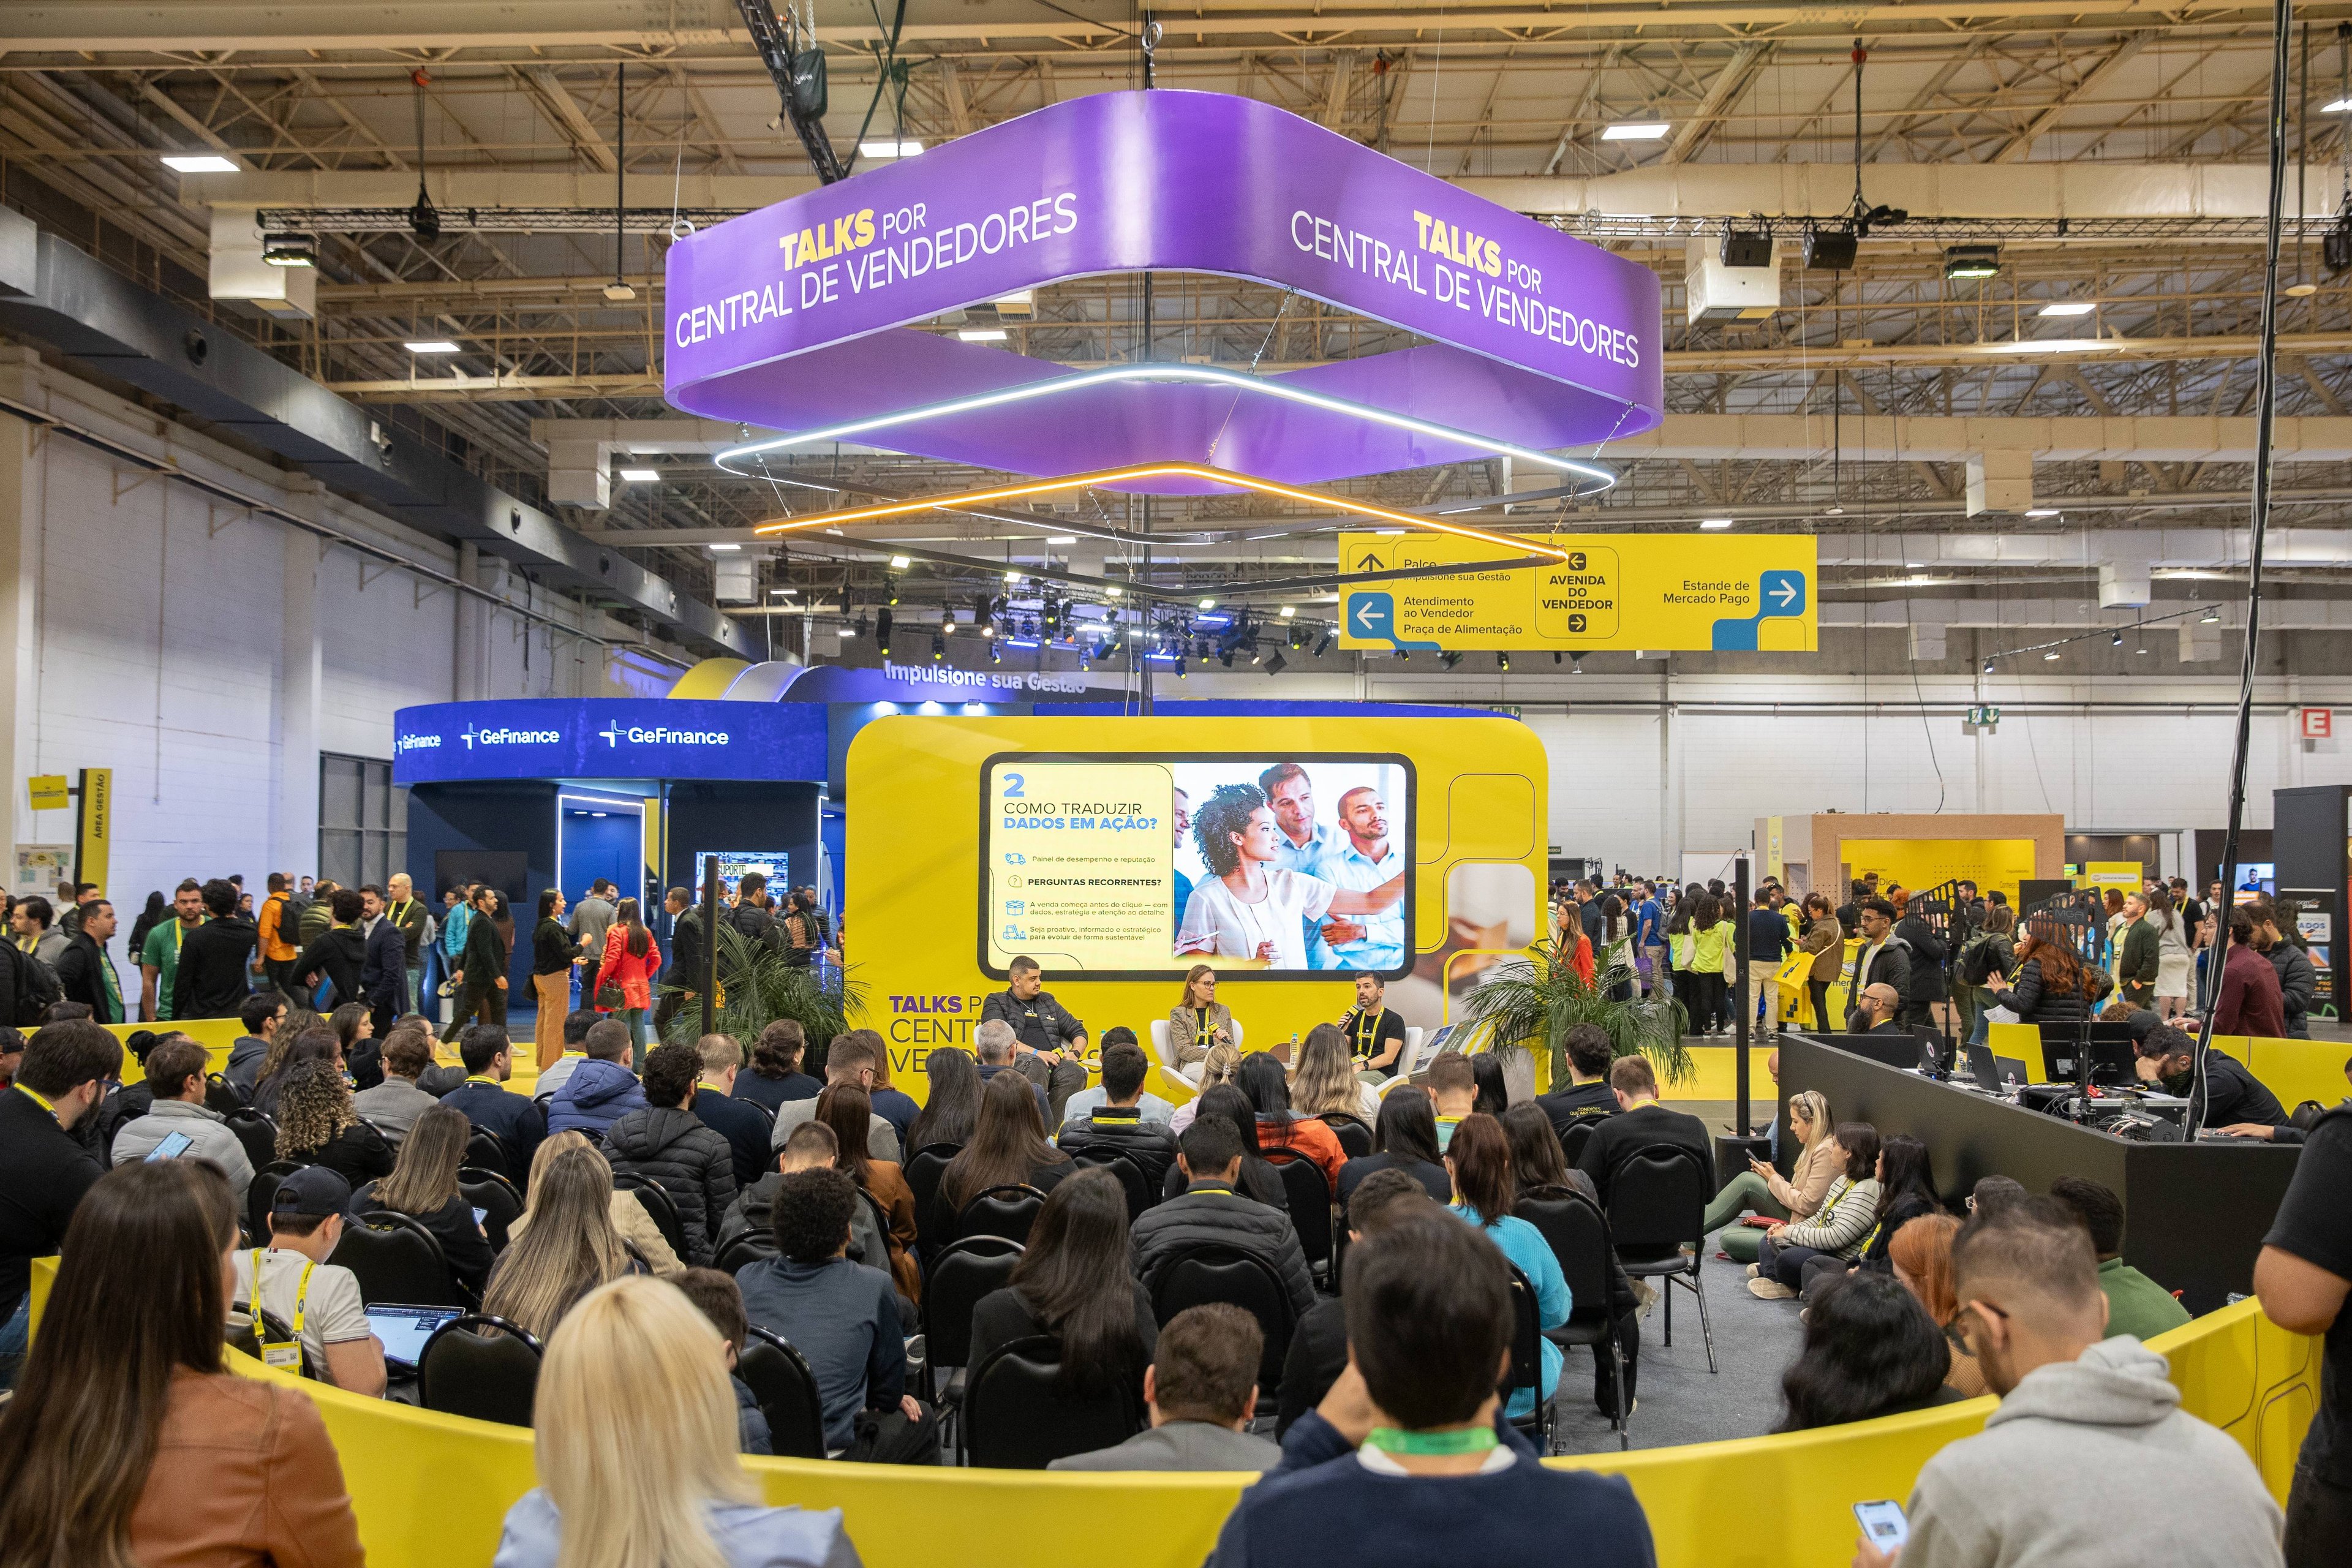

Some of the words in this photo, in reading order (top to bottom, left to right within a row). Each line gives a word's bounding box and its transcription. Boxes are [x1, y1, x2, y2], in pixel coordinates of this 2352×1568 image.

[779, 208, 875, 270] TALKS
[883, 202, 926, 240] POR
[1414, 209, 1502, 277] TALKS
[1507, 258, 1541, 294] POR
[676, 281, 793, 349] CENTRAL
[801, 265, 839, 310] DE
[846, 192, 1077, 294] VENDEDORES
[1291, 210, 1427, 296] CENTRAL
[1435, 263, 1470, 311] DE
[1477, 279, 1639, 368] VENDEDORES
[1404, 573, 1455, 582] mpulsione
[1477, 573, 1510, 581] Gestão
[1549, 576, 1606, 586] AVENIDA
[1683, 581, 1731, 590] Estande
[1735, 581, 1749, 590] de
[1403, 596, 1474, 606] Atendimento
[1568, 588, 1587, 597] DO
[1664, 593, 1716, 603] Mercado
[1720, 593, 1750, 606] Pago
[1420, 608, 1474, 618] Vendedor
[1542, 600, 1613, 610] VENDEDOR
[1404, 624, 1434, 635] Praça
[1438, 624, 1451, 633] de
[1454, 624, 1522, 636] Alimentação
[884, 660, 986, 687] Impulsione
[992, 674, 1023, 690] sua
[2306, 712, 2327, 734] E
[480, 728, 560, 745] GeFinance
[628, 726, 729, 745] GeFinance
[97, 774, 106, 811] GESTÃO
[1003, 773, 1024, 797] 2
[1005, 803, 1055, 814] COMO
[1061, 803, 1142, 815] TRADUZIR
[93, 813, 104, 839] ÁREA
[1004, 818, 1065, 829] DADOS
[1070, 818, 1095, 829] EM
[1100, 815, 1158, 832] AÇÃO?
[2055, 910, 2084, 918] MGA
[889, 995, 962, 1013] TALKS
[890, 1019, 982, 1043] CENT
